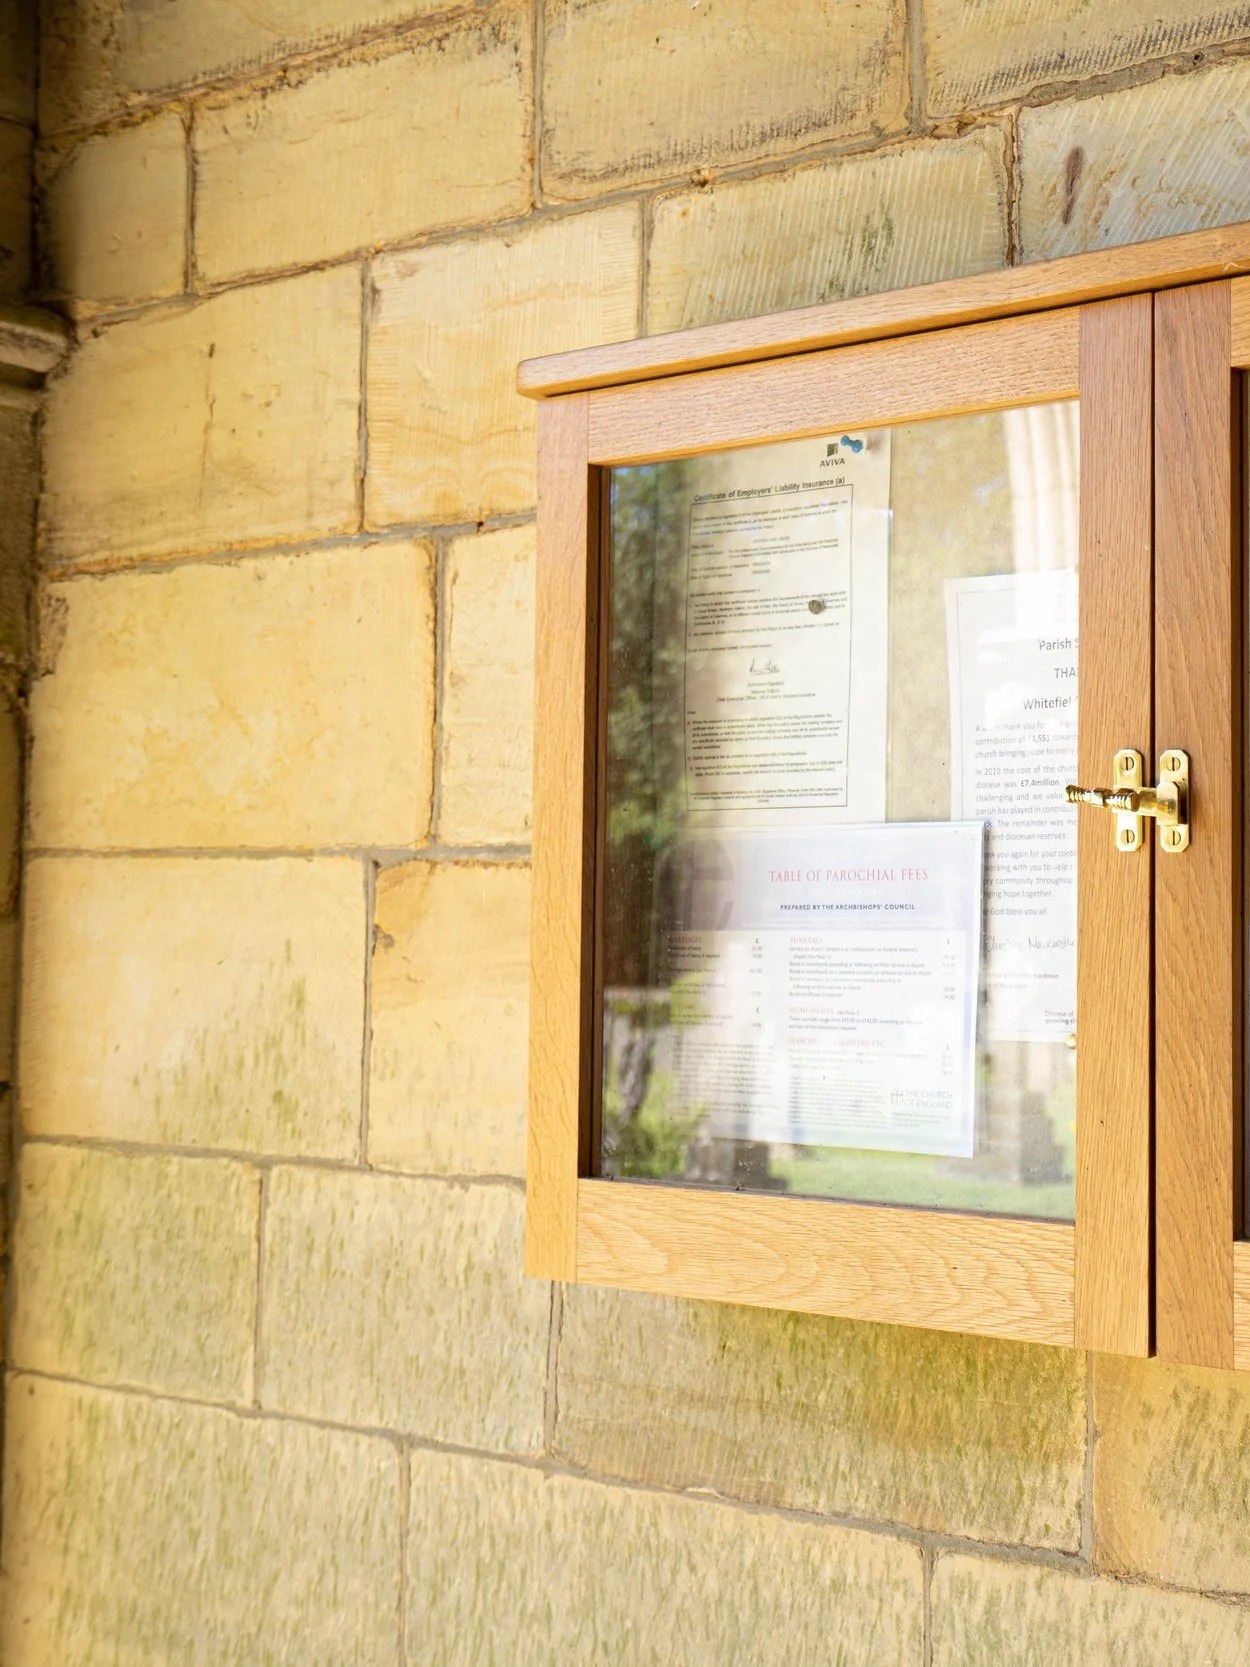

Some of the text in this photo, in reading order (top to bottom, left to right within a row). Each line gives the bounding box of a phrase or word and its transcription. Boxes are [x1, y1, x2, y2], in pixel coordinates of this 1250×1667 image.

[820, 458, 845, 467] AVIVA
[694, 477, 845, 502] Certificate of Employers' Liability Insurance (a)
[1040, 638, 1071, 651] Parish
[1023, 696, 1077, 710] Whitefiel
[976, 780, 1001, 789] diocese
[768, 867, 928, 882] TABLE OF PAROCHIAL FEES
[904, 1088, 952, 1099] THE CHURCH
[902, 1099, 952, 1110] OF ENGLAND
